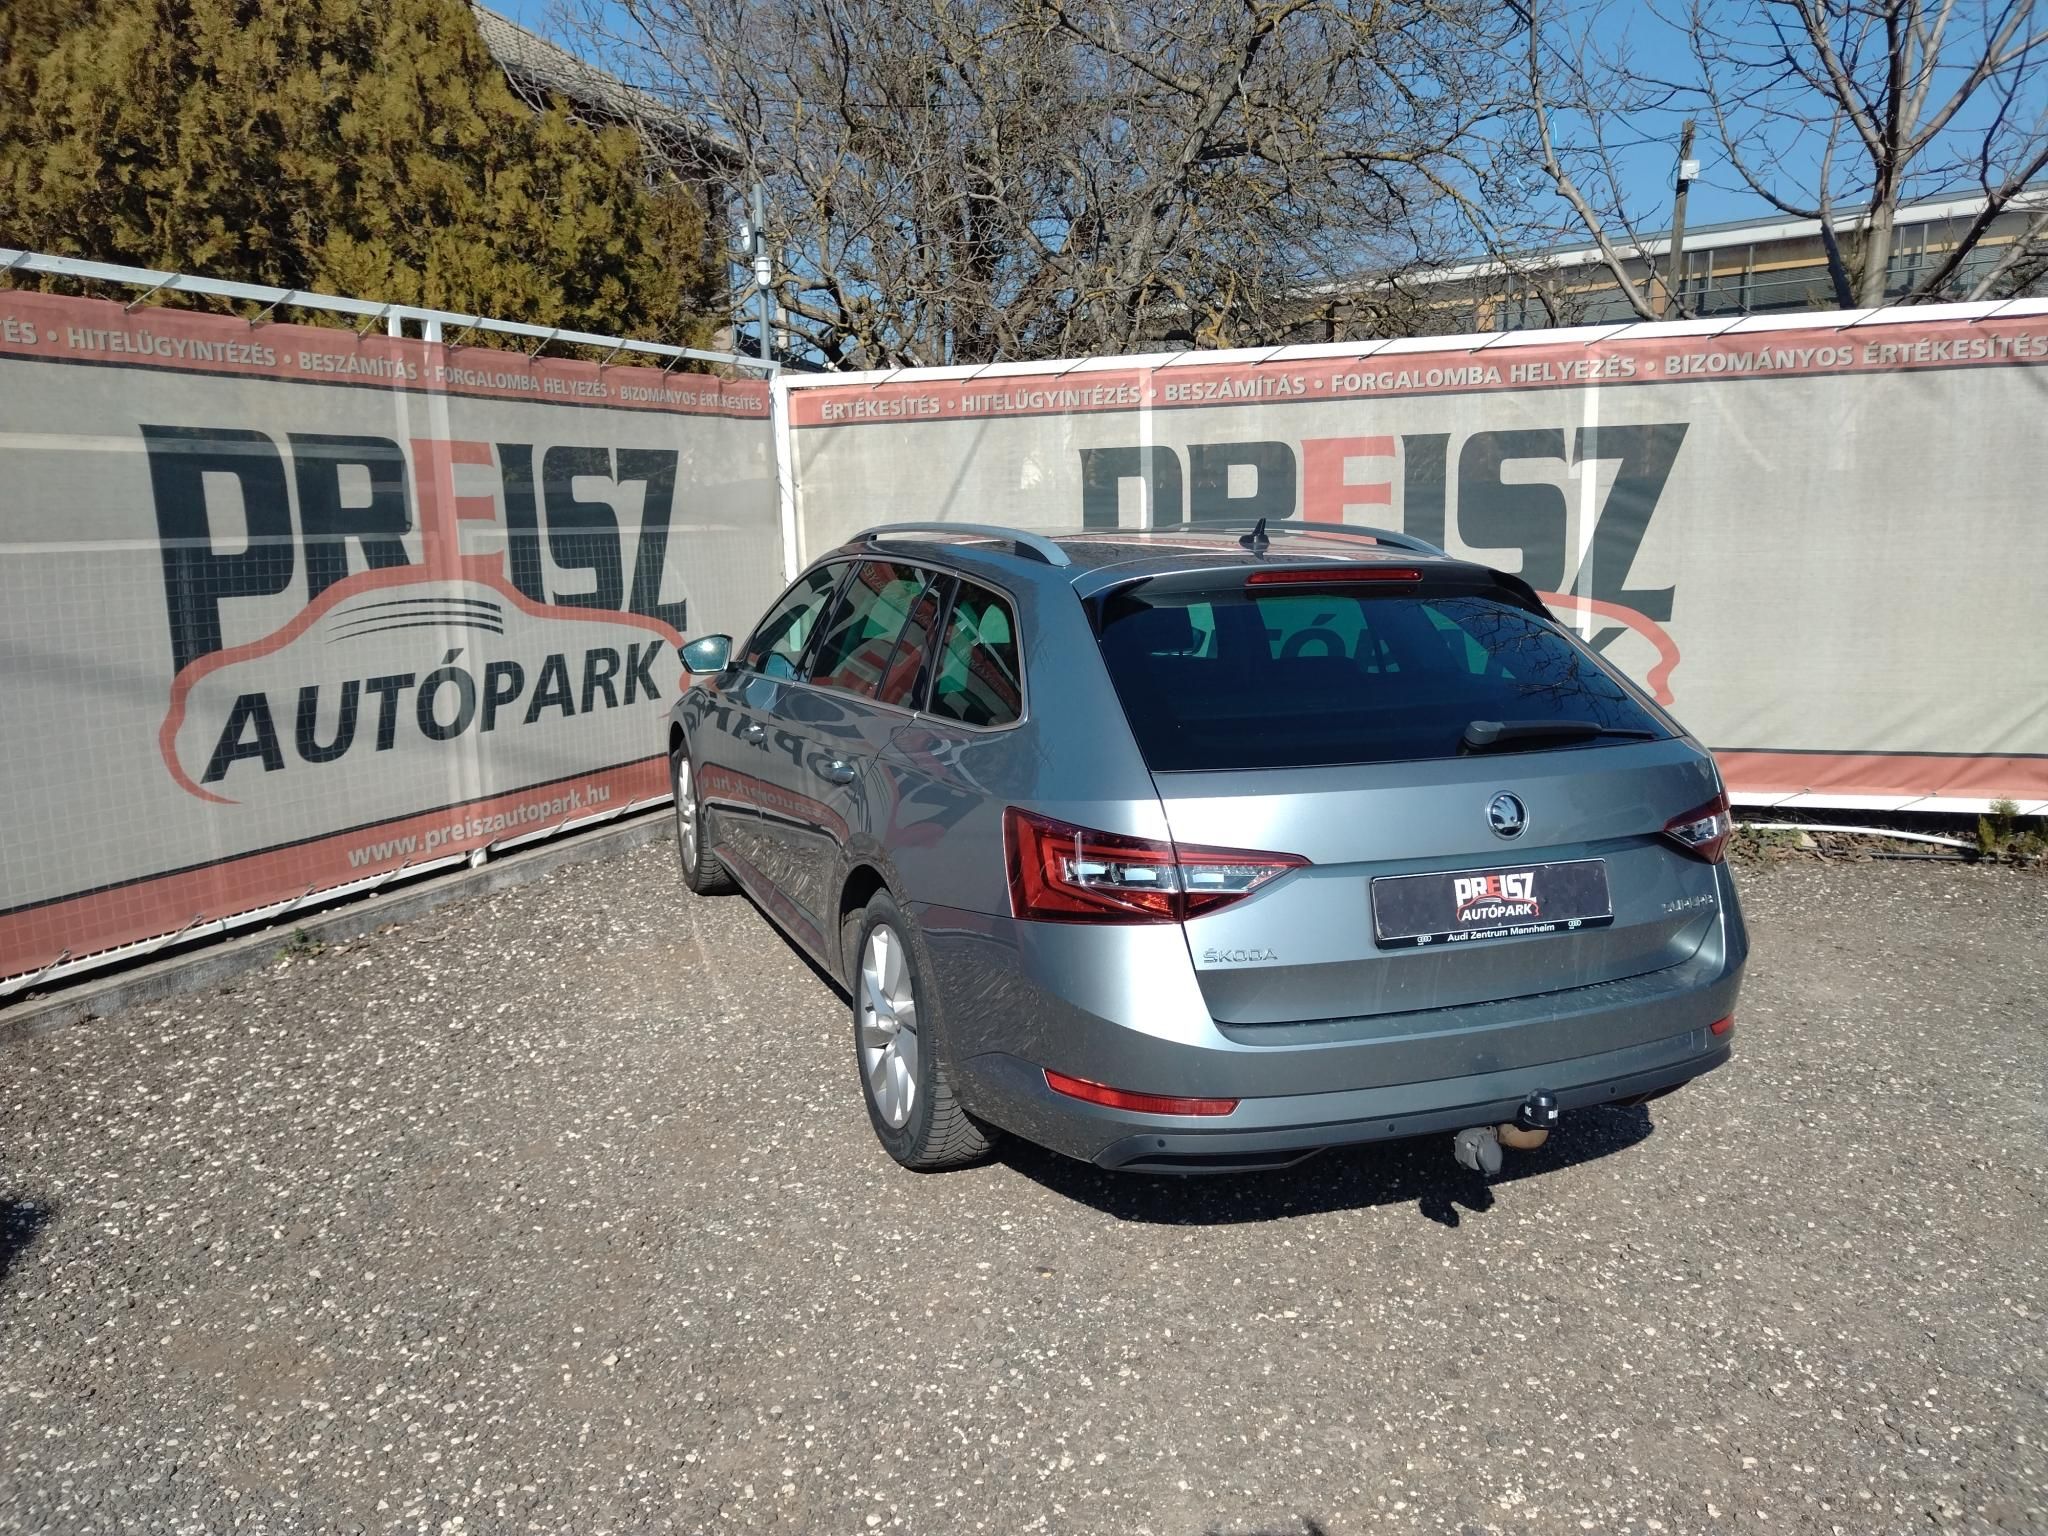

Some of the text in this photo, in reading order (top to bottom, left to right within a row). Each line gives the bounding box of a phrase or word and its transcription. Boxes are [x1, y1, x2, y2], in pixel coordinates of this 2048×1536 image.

[0, 315, 38, 345] ÉS
[67, 327, 276, 367] HITELÜGYINTÉZÉS
[299, 351, 417, 380] BESZÁMÍTÁS
[435, 366, 540, 392] FORGALOMBA
[544, 377, 607, 397] HELYEZÉS
[620, 384, 696, 406] BIZOMÁNYOS
[821, 332, 2048, 421] ÉRTÉKESÍTÉS HITELÜGYINTÉZÉS BESZÁMÍTÁS FORGALOMBA HELYEZÉS BIZOMÁNYOS ÉRTÉKESÍTÉS
[138, 423, 687, 677] PREISZ
[201, 648, 665, 785] AUTÓPARK
[348, 783, 610, 868] www.preiszautopark.hu
[1447, 924, 1555, 942] Audi Zentrum Mannheim
[1454, 872, 1537, 908] PREISZ
[1461, 904, 1532, 921] AUTÓPARK
